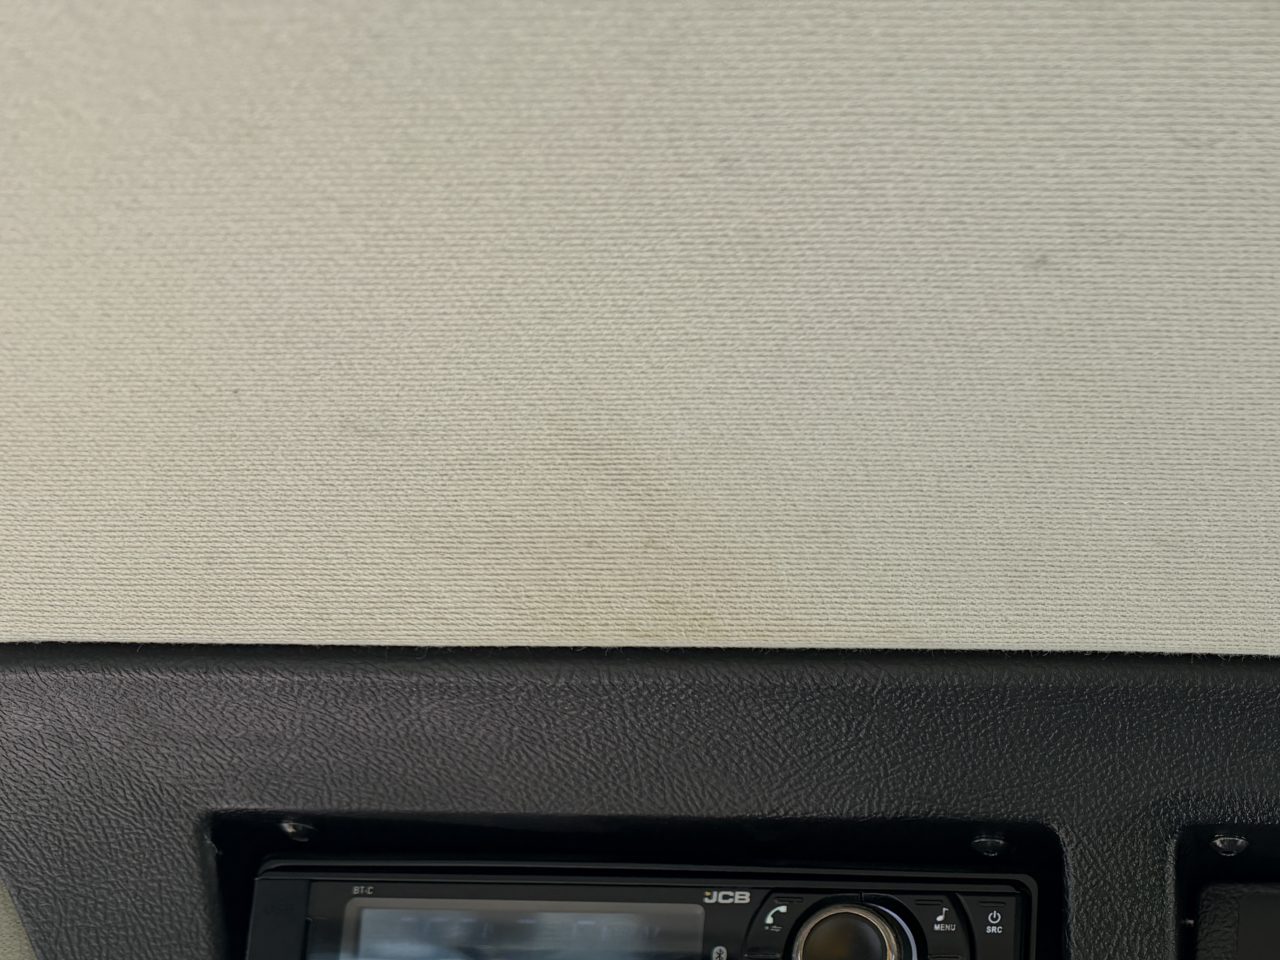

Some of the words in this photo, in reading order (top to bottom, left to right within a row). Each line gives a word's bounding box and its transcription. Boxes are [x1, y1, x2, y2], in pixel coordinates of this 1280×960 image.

[704, 891, 750, 904] JCB
[934, 923, 956, 931] MENU
[986, 926, 1003, 934] SRC
